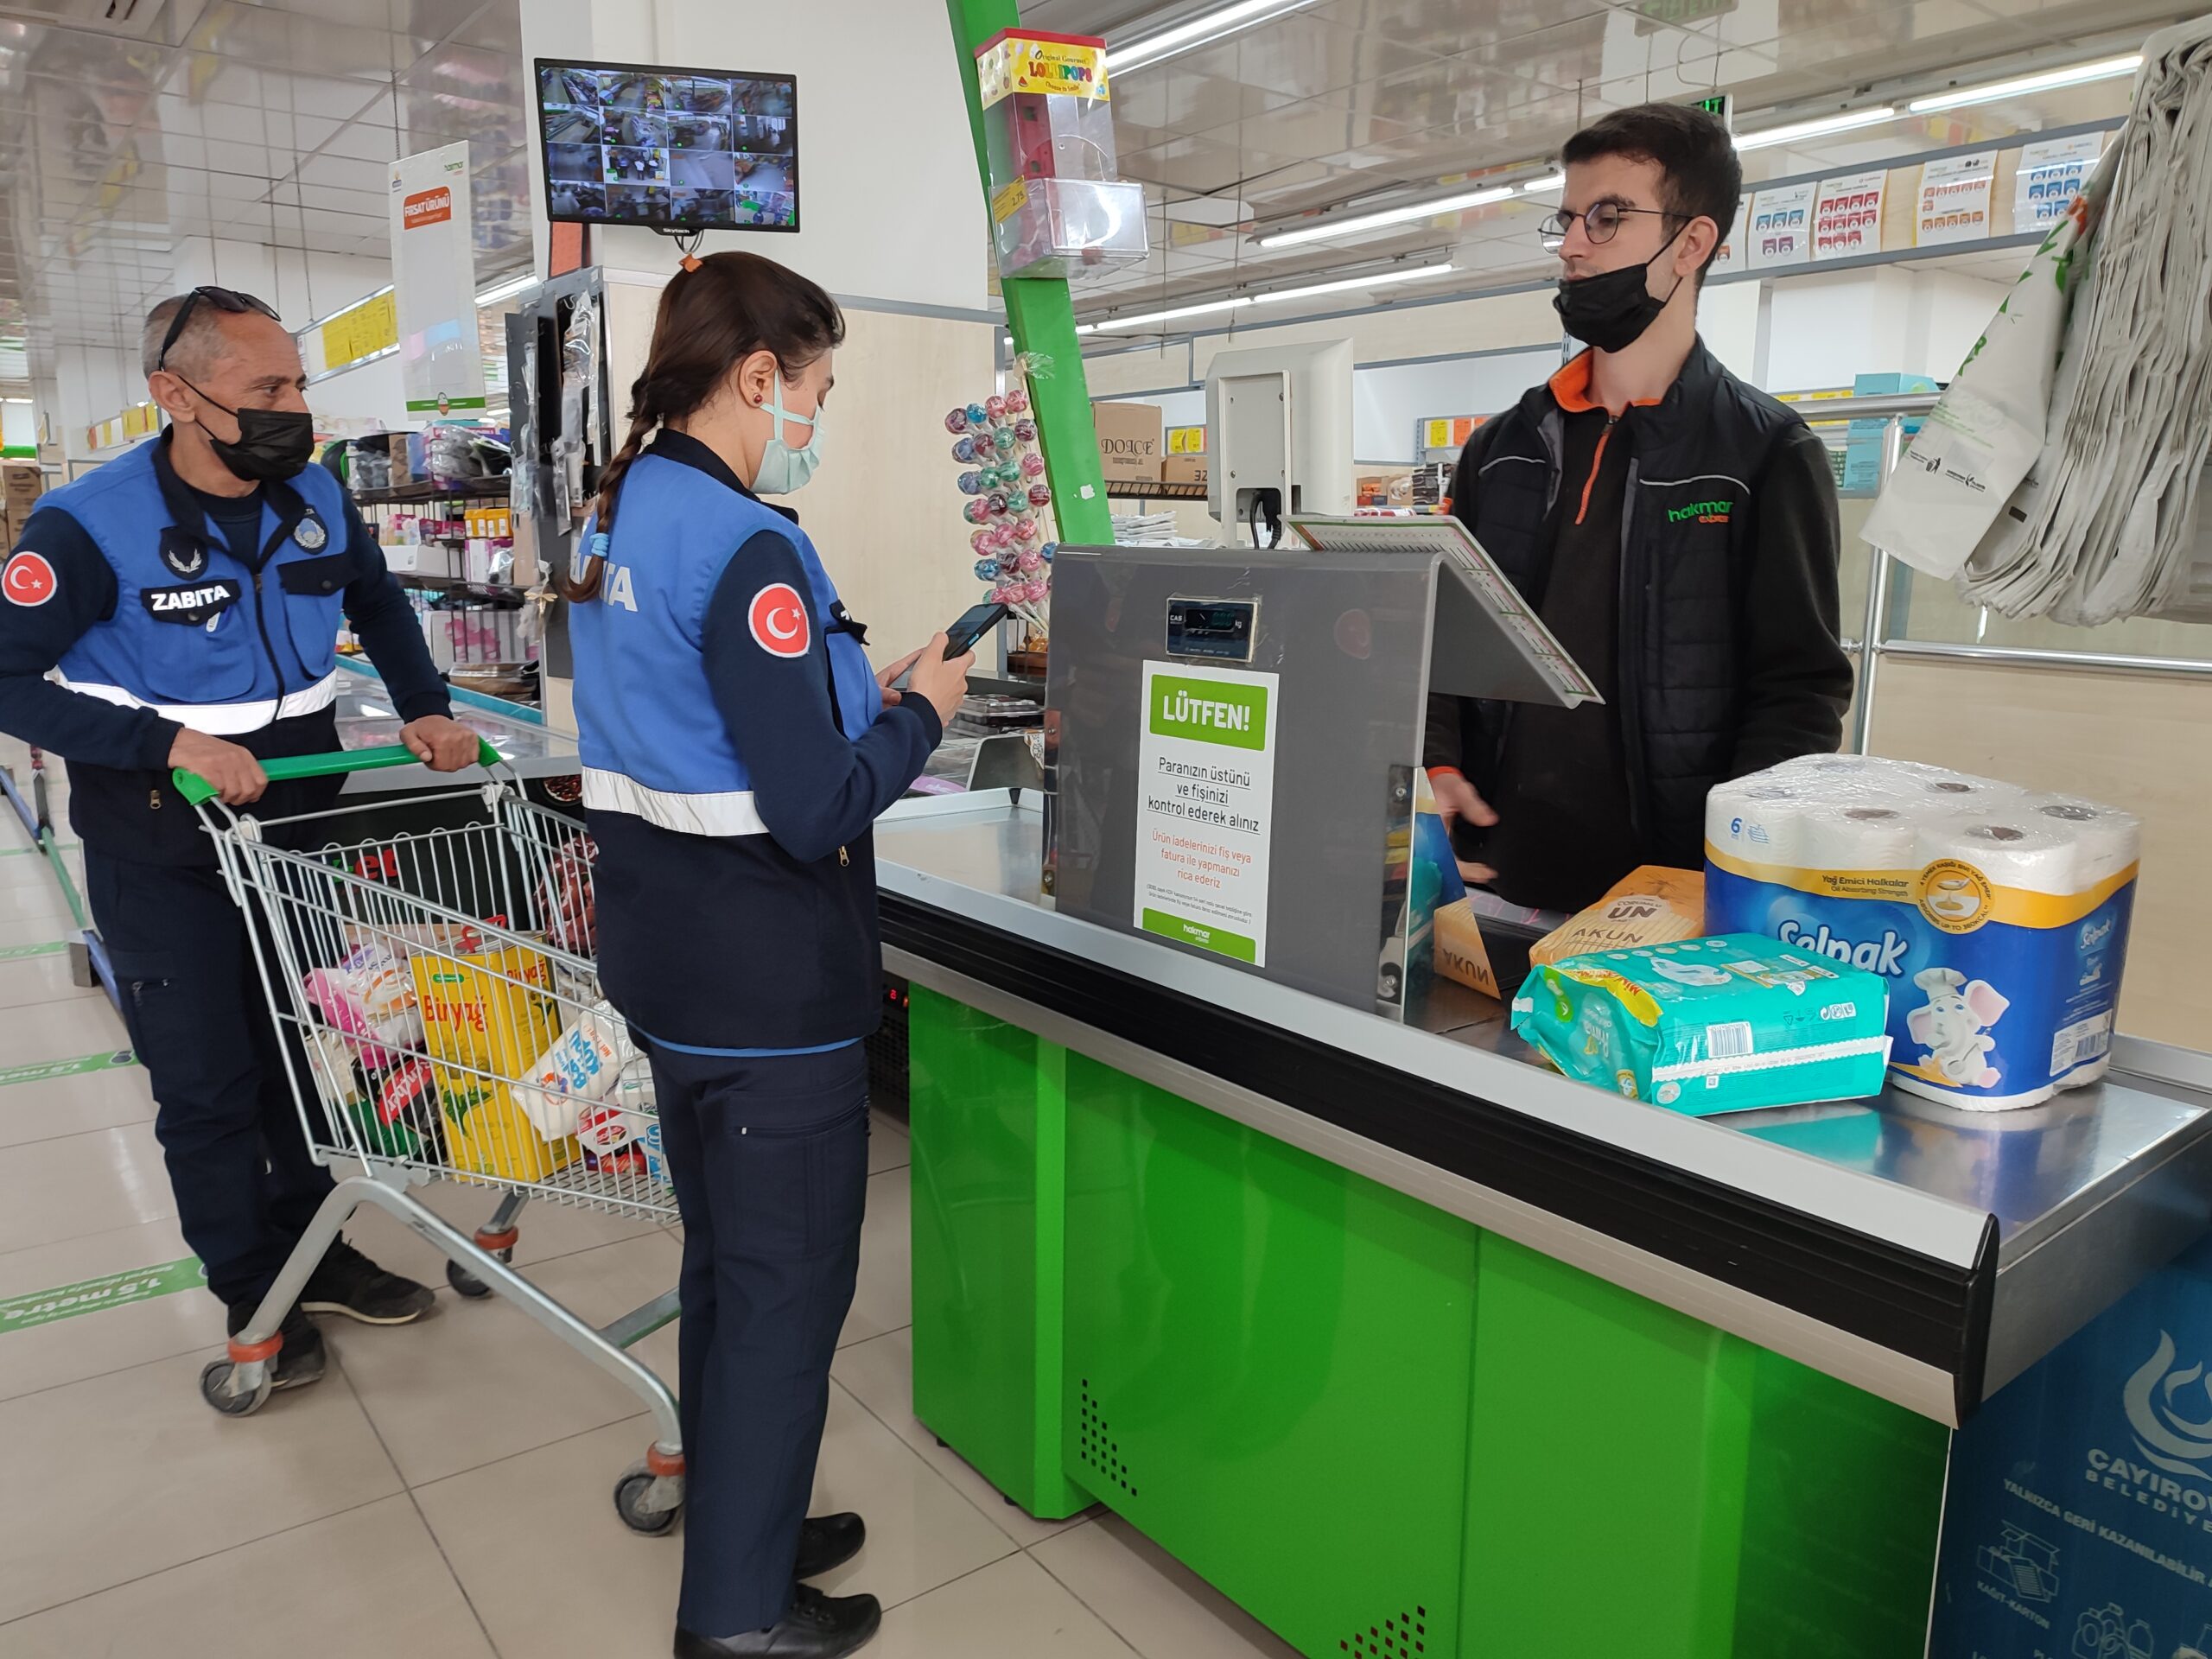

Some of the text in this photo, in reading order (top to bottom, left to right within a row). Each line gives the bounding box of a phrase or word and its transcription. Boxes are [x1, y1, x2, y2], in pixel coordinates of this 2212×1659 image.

[1028, 61, 1093, 83] LOLLIPOPS
[1101, 438, 1154, 457] DOLCE
[150, 584, 231, 612] ZABITA
[1163, 690, 1250, 732] LÜTFEN!
[1159, 756, 1251, 786] Paranızın üstünü
[1177, 784, 1229, 804] ve fişinizi
[1148, 795, 1259, 832] kontrol ederek alınız
[1731, 817, 1743, 834] 6
[1152, 828, 1251, 864] Ürün iadelerinizi fiş veya
[1161, 848, 1240, 877] fatura ile yapmanızı
[1177, 869, 1221, 888] rica ederiz
[1822, 874, 1909, 887] Yağ Emici Halkalar
[1608, 906, 1658, 920] UN
[1572, 927, 1644, 944] AKUN
[423, 995, 488, 1033] Biryağ
[2087, 1448, 2212, 1519] ÇAYIRO
[2003, 1478, 2060, 1517] YALNIZCA
[2063, 1510, 2095, 1534] GERİ
